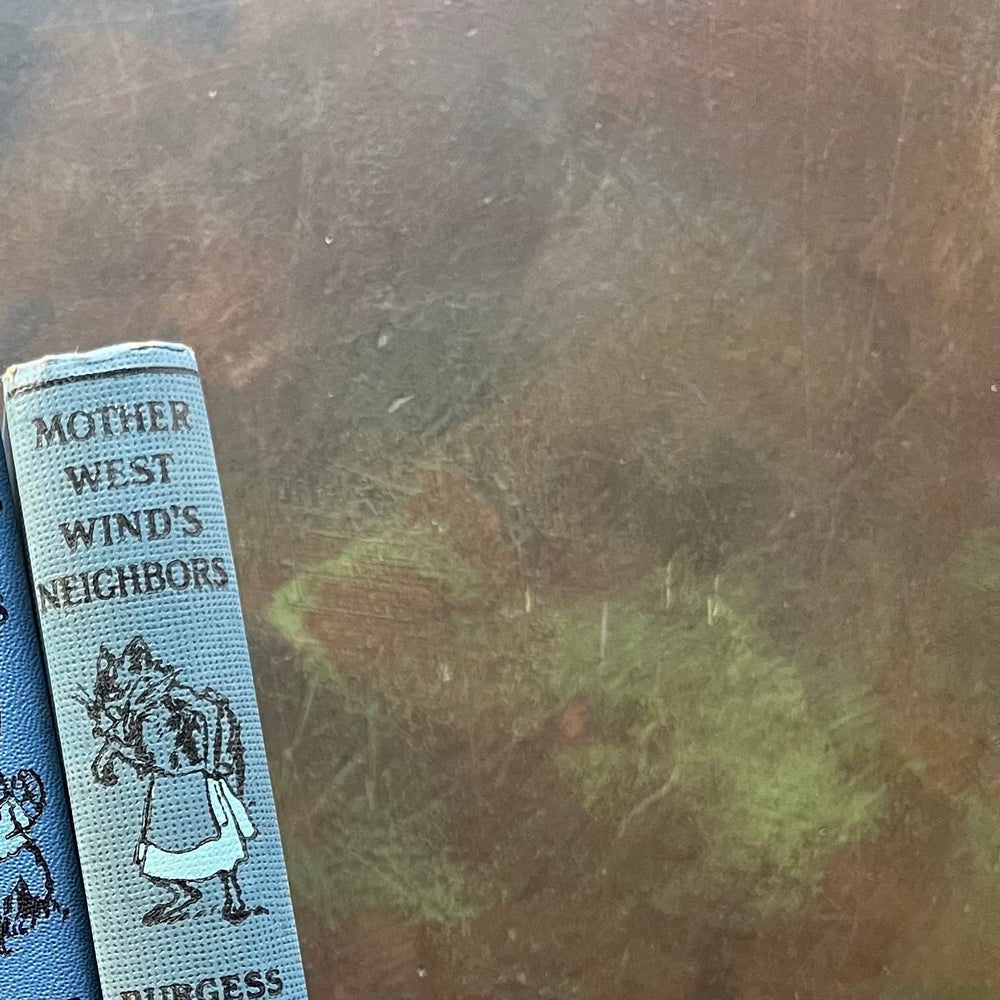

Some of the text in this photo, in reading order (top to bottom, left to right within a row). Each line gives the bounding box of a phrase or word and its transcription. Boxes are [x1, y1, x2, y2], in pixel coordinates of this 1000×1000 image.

[31, 400, 191, 450] MOTHER
[64, 453, 174, 495] WEST
[59, 505, 203, 551] WIND'S
[38, 557, 229, 613] NEIGHBORS
